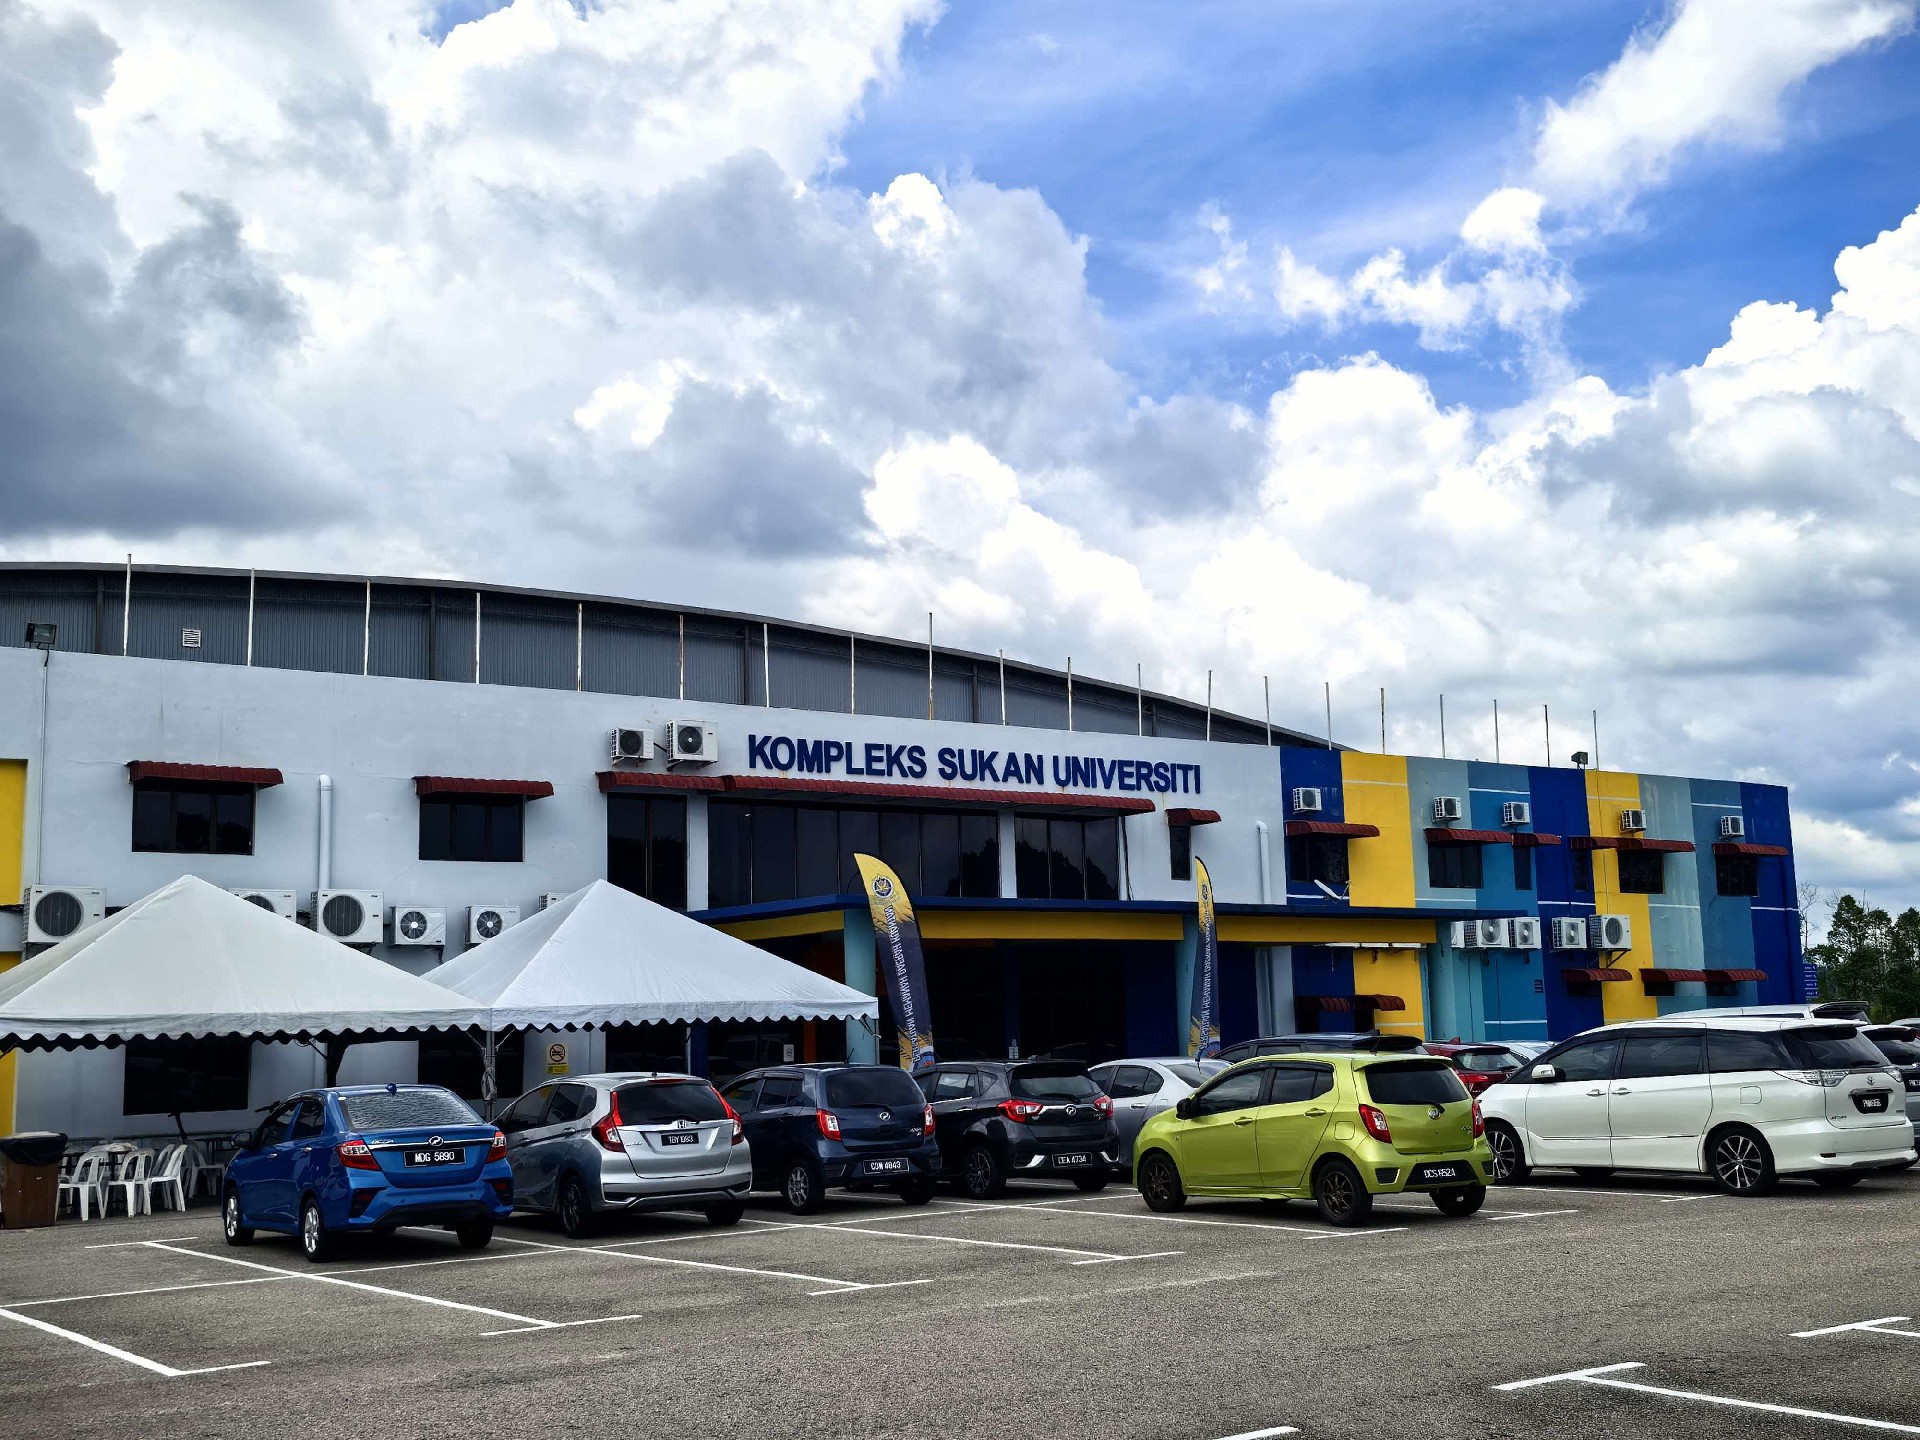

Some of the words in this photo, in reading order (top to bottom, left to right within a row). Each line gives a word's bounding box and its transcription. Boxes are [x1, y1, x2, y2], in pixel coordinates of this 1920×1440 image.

[748, 734, 927, 779] KOMPLEKS
[938, 747, 1045, 785] SUKAN
[1053, 755, 1201, 794] UNIVERSITI
[414, 1152, 431, 1163] MDG
[434, 1151, 455, 1162] 5890
